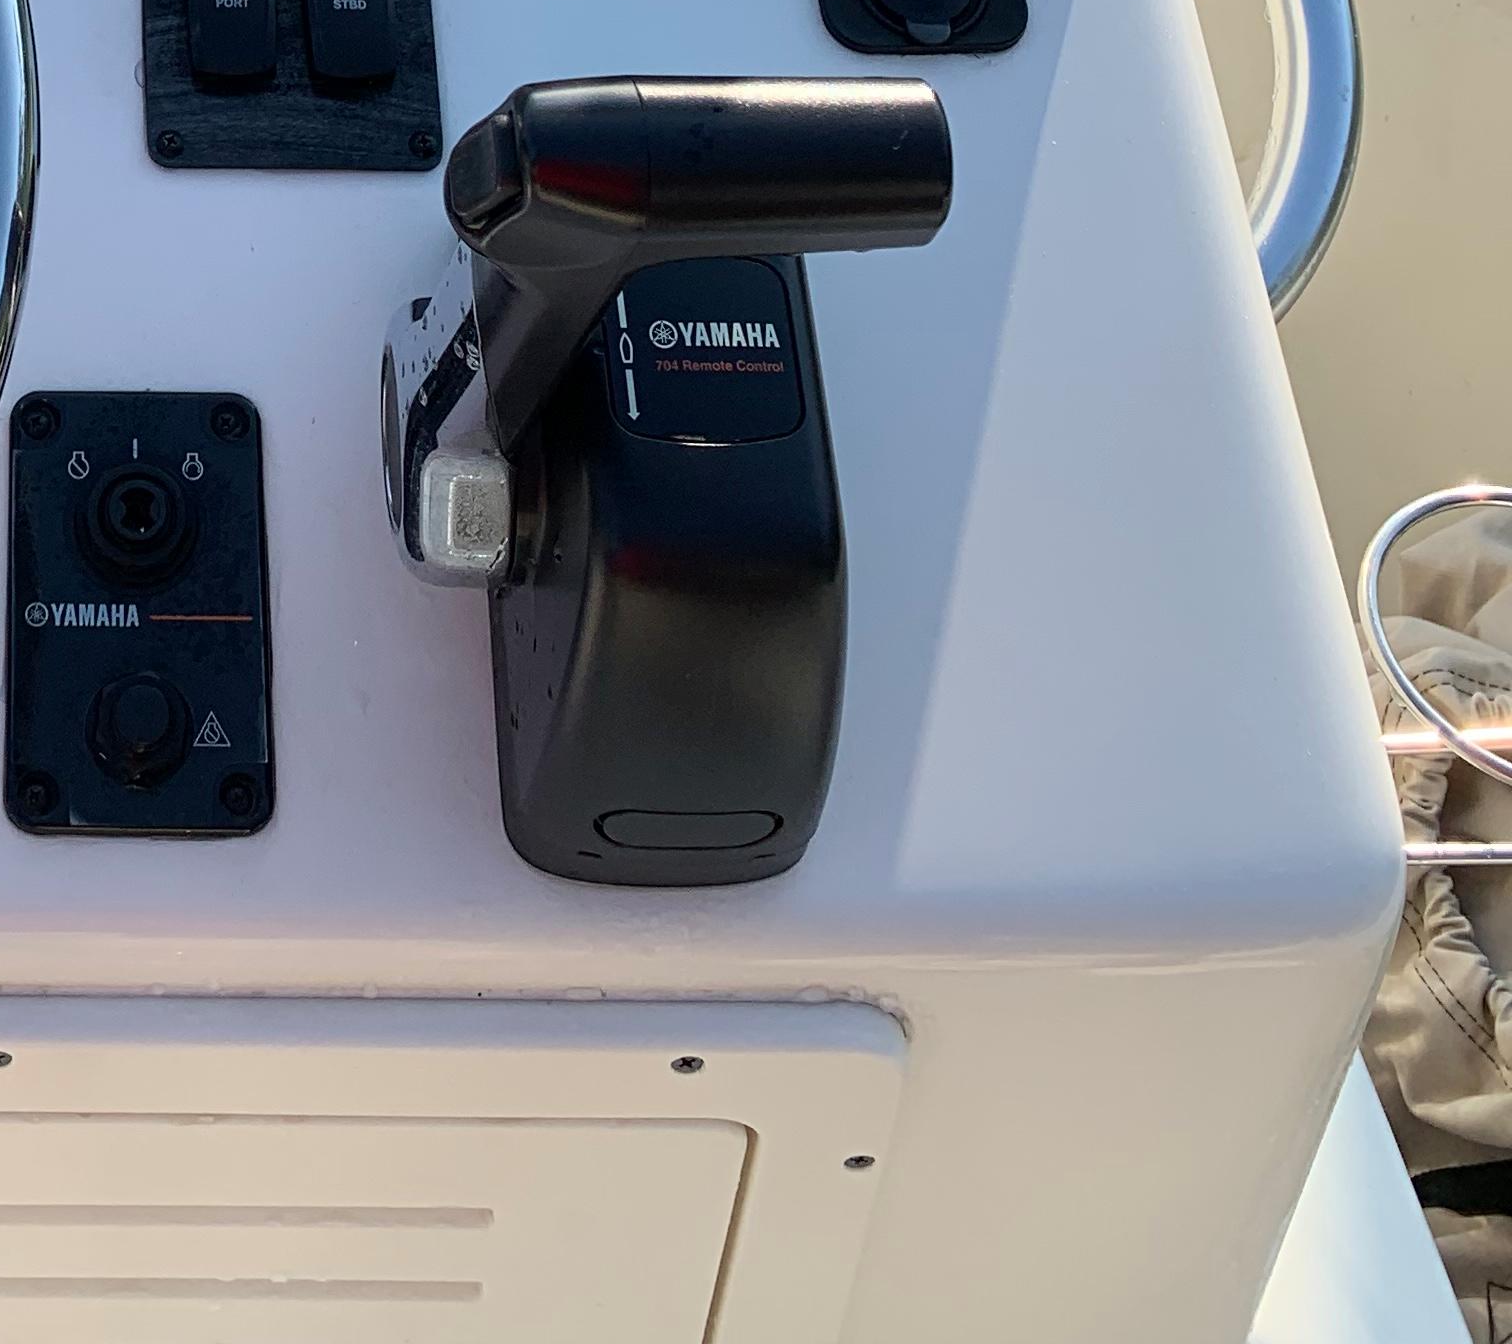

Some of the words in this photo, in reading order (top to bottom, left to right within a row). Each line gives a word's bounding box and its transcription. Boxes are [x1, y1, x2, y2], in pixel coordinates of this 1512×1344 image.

[677, 322, 781, 348] YAMAHA
[654, 359, 680, 372] 704
[681, 359, 734, 374] Remote
[735, 359, 785, 374] Control
[50, 603, 140, 628] YAMAHA
